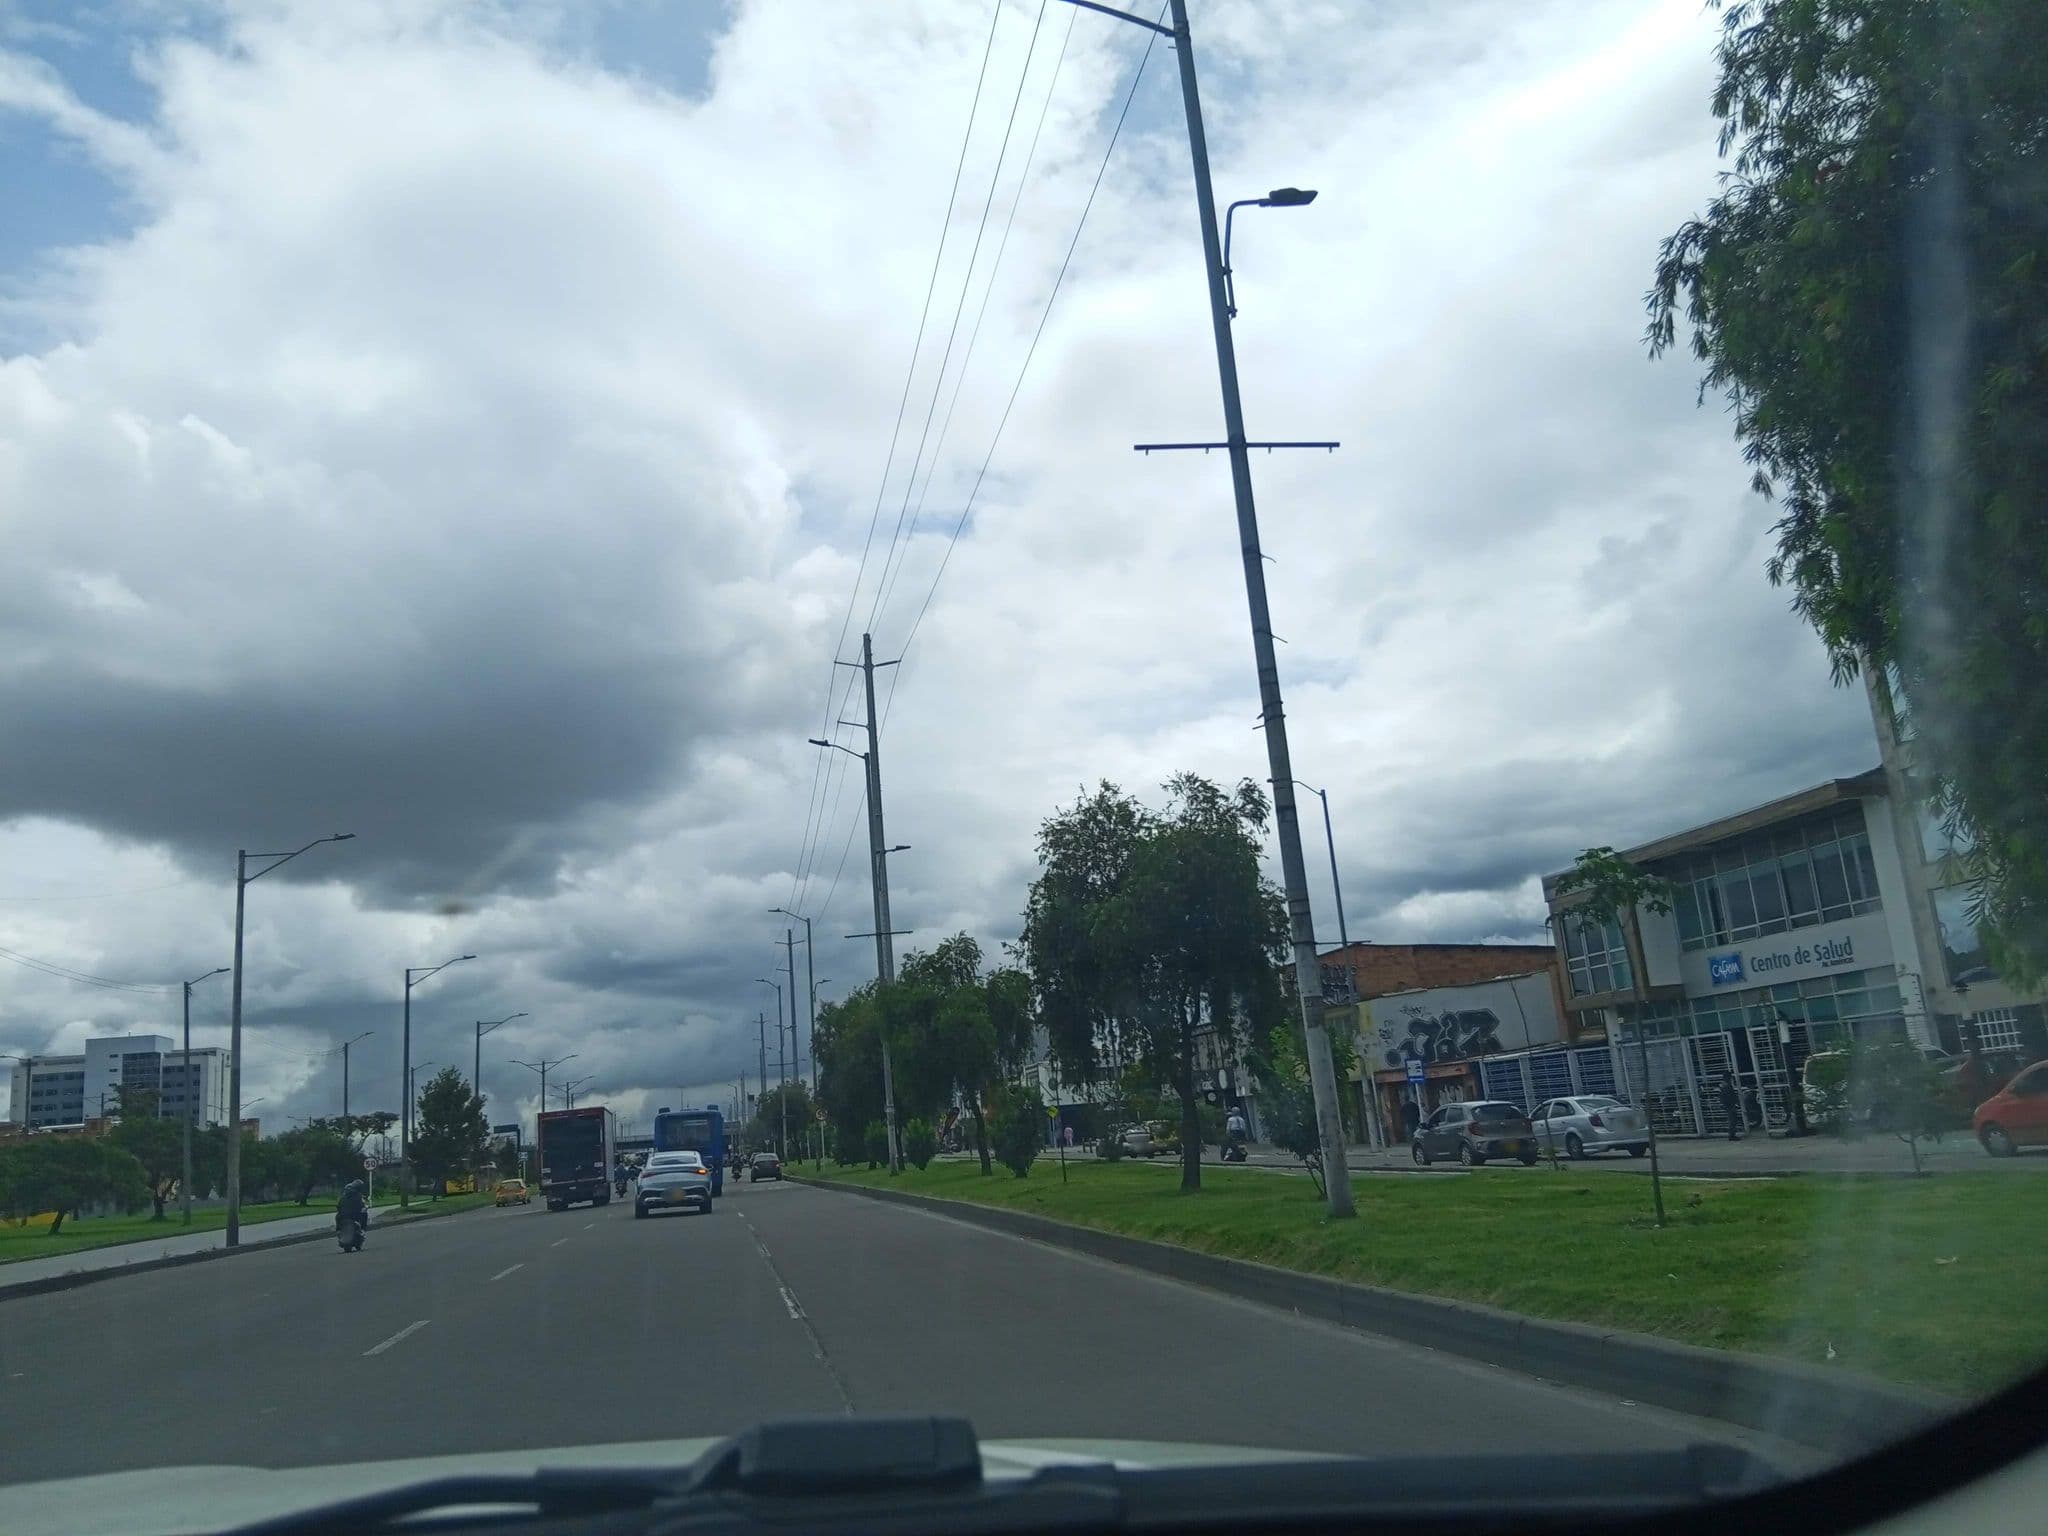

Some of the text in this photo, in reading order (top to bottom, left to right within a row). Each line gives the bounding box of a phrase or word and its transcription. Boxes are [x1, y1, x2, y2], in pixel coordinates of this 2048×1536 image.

[1751, 952, 1791, 972] Centro
[1794, 946, 1811, 965] de
[1814, 936, 1853, 961] Salud
